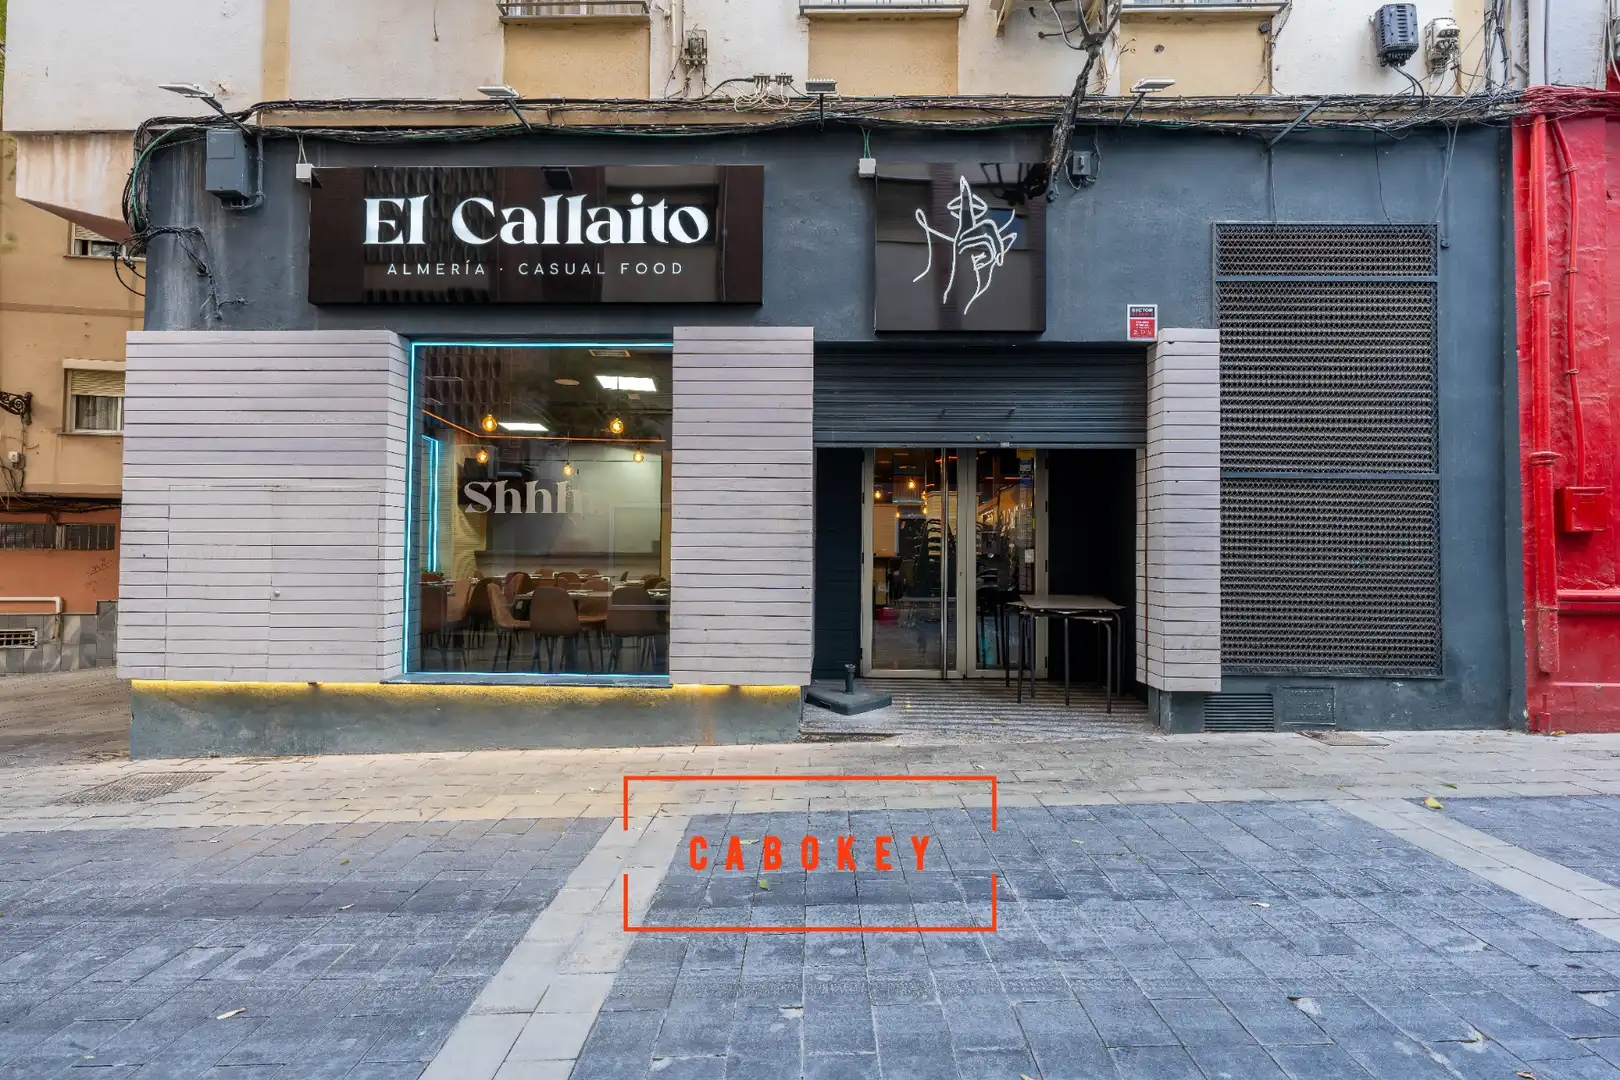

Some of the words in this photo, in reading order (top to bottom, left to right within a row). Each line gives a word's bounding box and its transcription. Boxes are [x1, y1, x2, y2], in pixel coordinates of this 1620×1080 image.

[363, 194, 430, 245] El
[451, 193, 709, 245] Callaito
[387, 259, 486, 275] ALMERÍA
[518, 262, 606, 275] CASUAL
[620, 262, 683, 275] FOOD
[464, 480, 582, 514] Shhh
